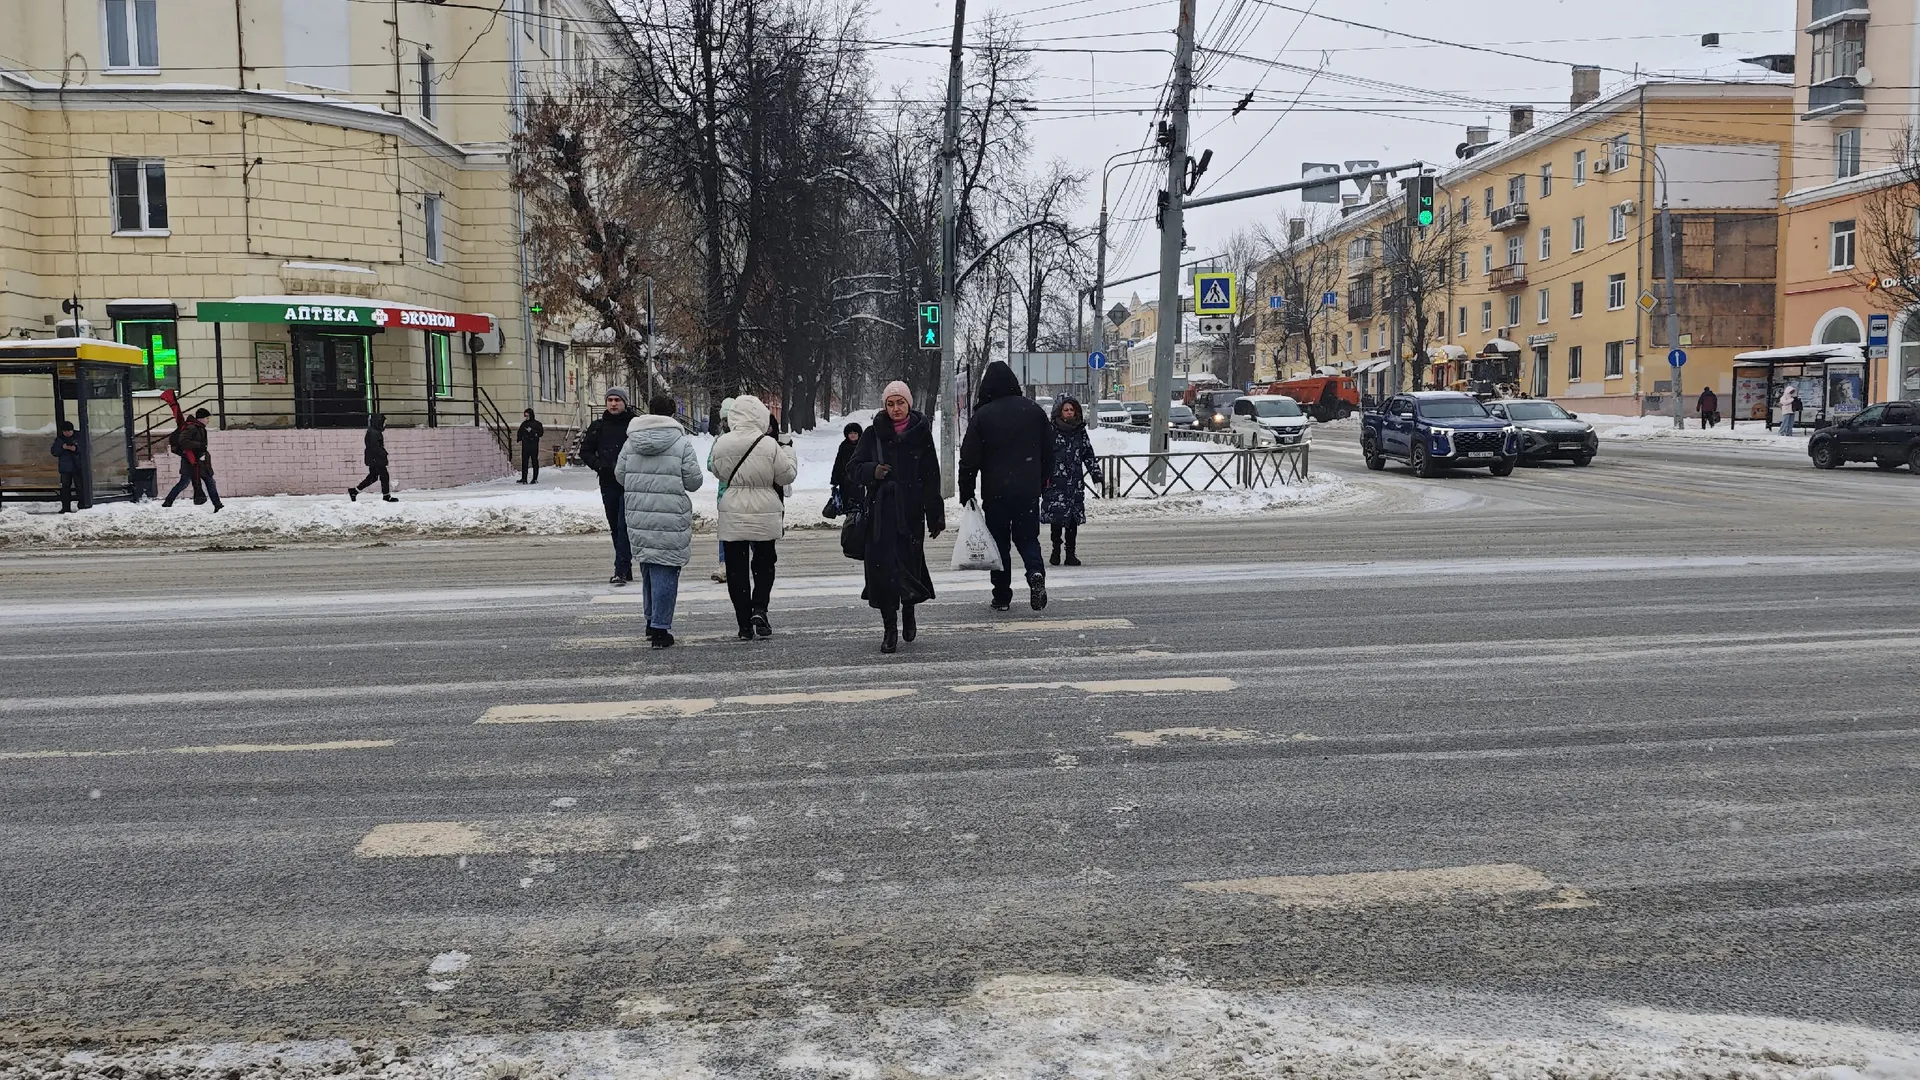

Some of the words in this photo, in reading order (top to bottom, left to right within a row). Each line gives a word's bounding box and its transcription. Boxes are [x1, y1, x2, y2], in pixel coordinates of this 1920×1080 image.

[1421, 196, 1432, 206] 40
[284, 306, 359, 323] АПТЕКА
[400, 310, 456, 328] ЭКОНОМ
[920, 306, 939, 323] 40
